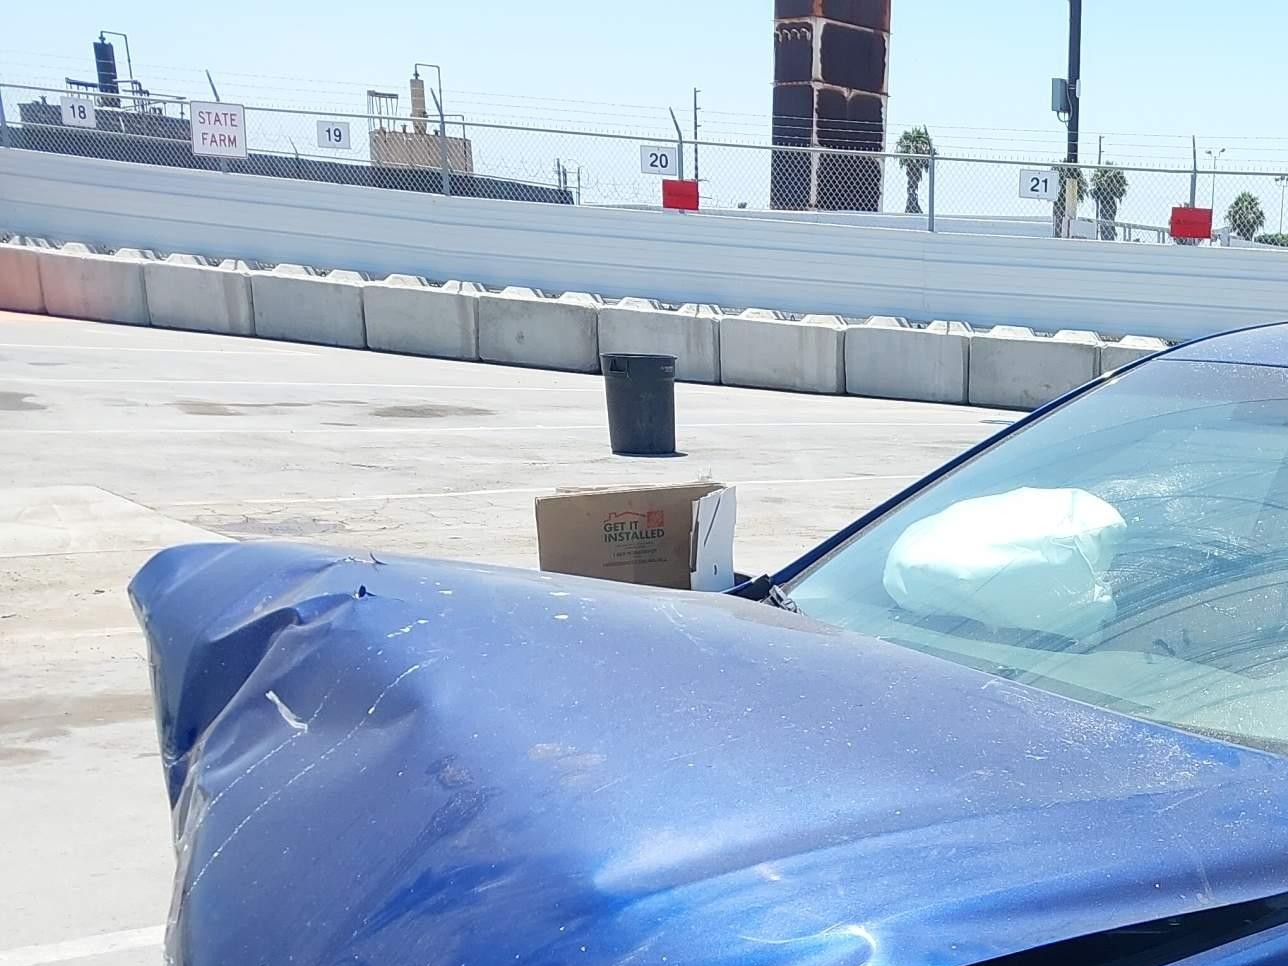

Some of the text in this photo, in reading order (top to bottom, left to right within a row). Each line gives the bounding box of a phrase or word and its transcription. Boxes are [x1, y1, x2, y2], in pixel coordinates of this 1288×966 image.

[70, 103, 87, 120] 18
[198, 110, 238, 128] STATE
[201, 131, 238, 148] FARM
[325, 127, 342, 143] 19
[649, 152, 669, 169] 20
[1030, 176, 1048, 193] 21
[603, 520, 639, 533] GET IT
[603, 528, 665, 543] INSTALLED
